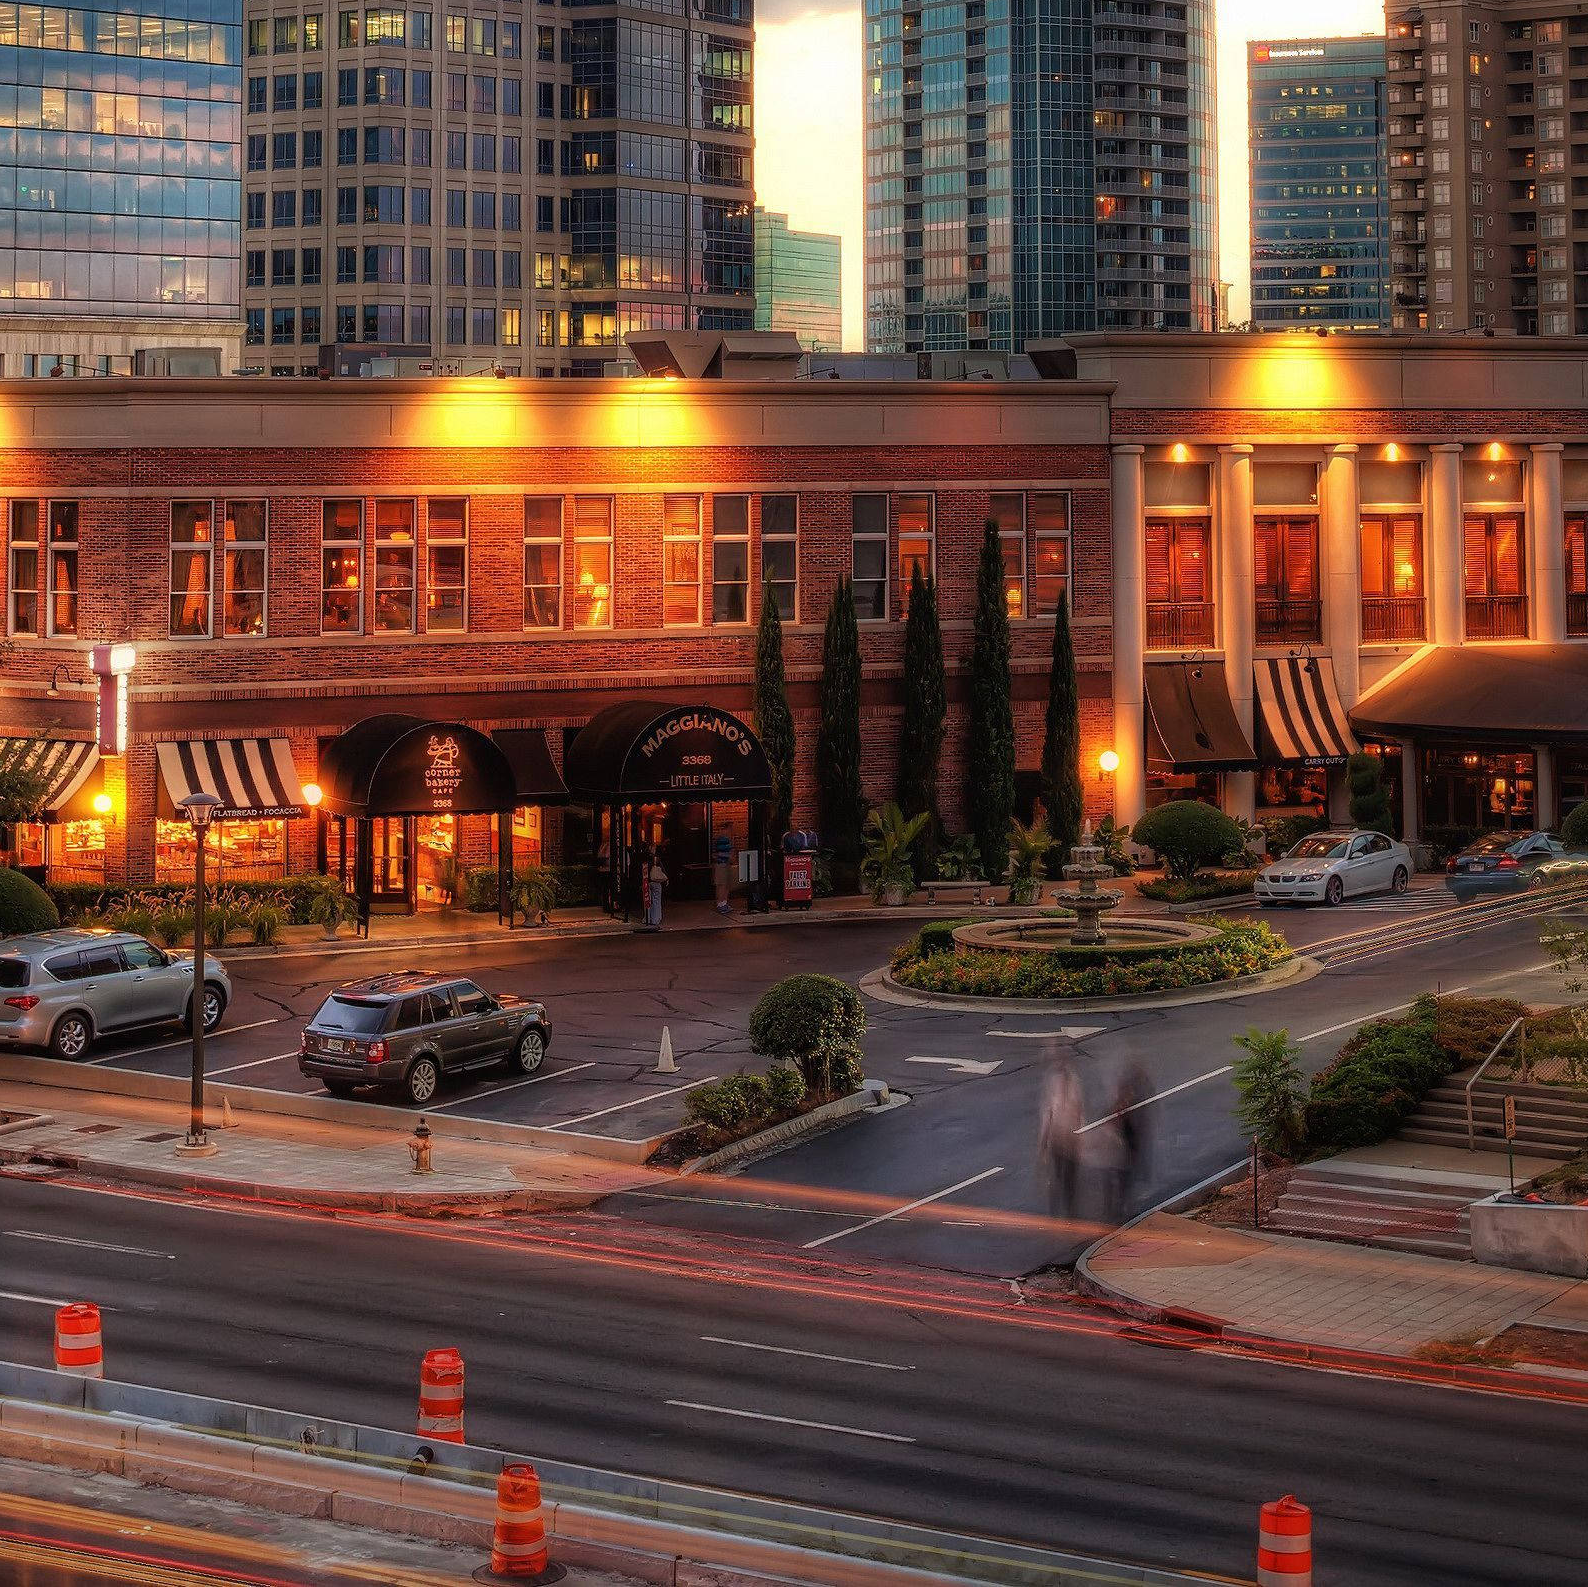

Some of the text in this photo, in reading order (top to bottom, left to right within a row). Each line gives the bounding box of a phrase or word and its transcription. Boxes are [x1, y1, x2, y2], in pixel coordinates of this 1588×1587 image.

[641, 713, 753, 758] MAGGIANO'S
[682, 755, 712, 765] 3368
[1305, 757, 1325, 765] CARRY
[425, 769, 461, 777] corner
[425, 778, 462, 788] bakery
[671, 773, 724, 787] LITTLE ITALY
[214, 807, 302, 817] FLATBREAD FOCACCIA
